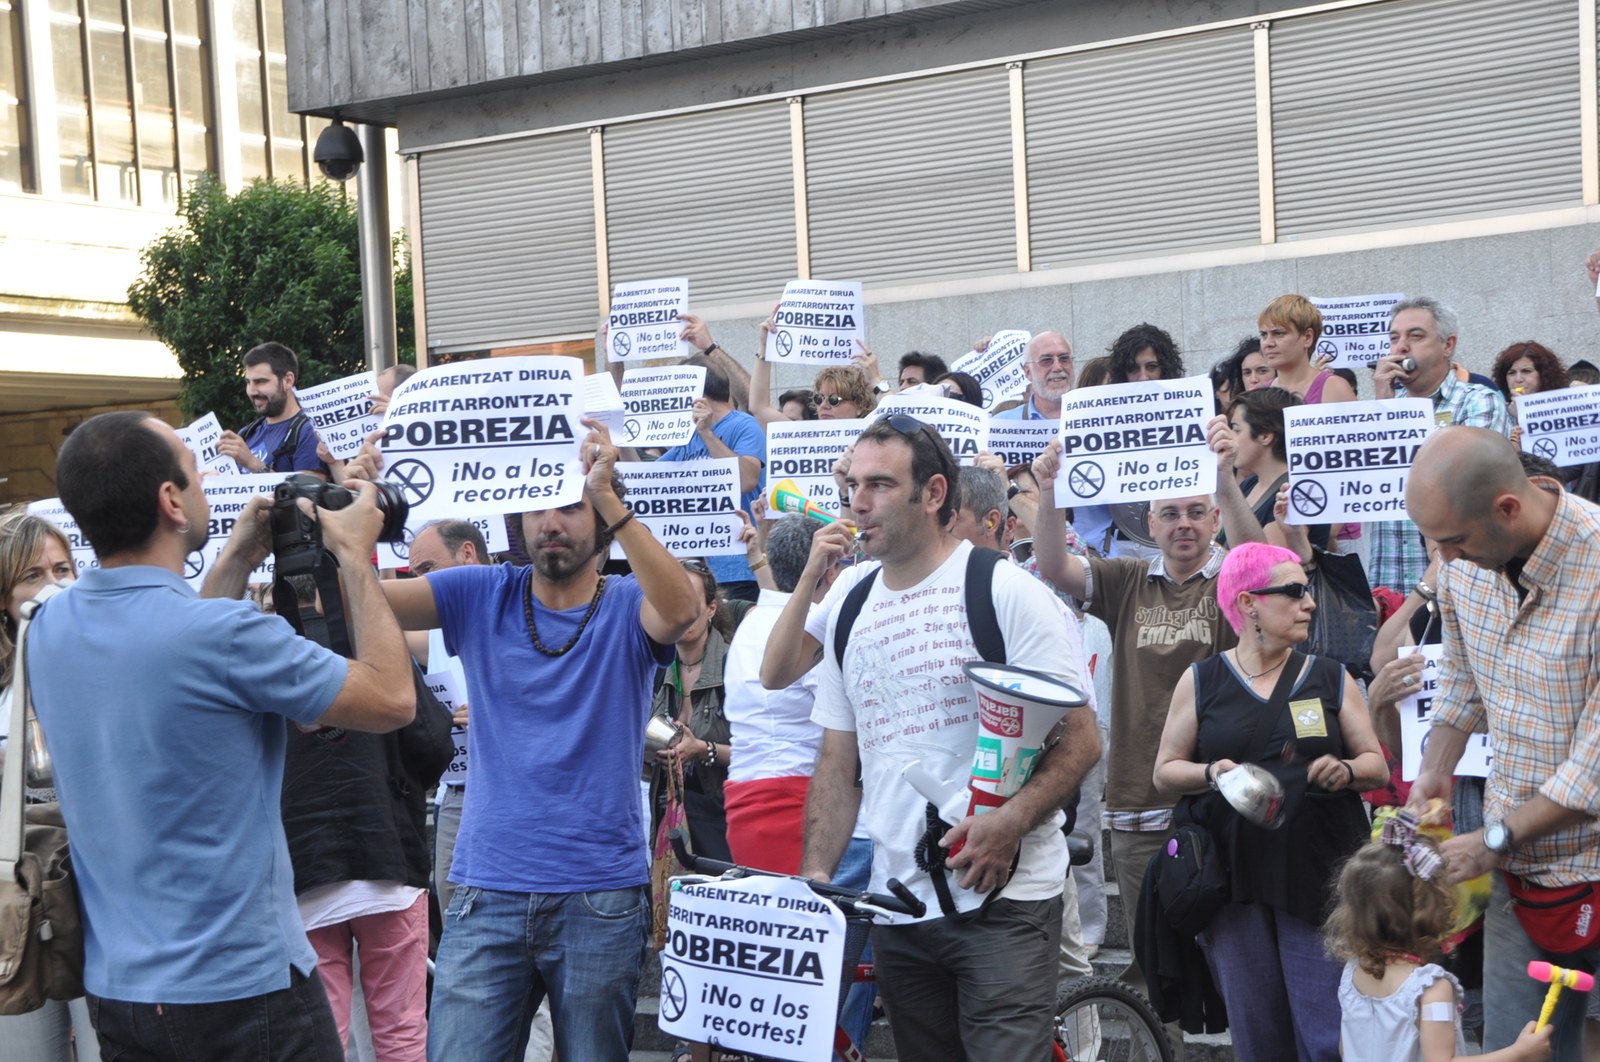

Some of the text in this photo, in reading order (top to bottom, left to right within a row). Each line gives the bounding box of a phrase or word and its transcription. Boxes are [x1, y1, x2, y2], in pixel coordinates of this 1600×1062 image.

[610, 309, 680, 326] POBREZIA
[776, 312, 856, 327] POBREZIA
[664, 330, 676, 340] los
[1324, 321, 1391, 335] OBREZI
[638, 341, 676, 353] recortes!
[834, 336, 852, 346] los
[1380, 340, 1390, 350] lo
[800, 348, 852, 358] recortes!
[519, 370, 572, 380] DIRUA
[344, 380, 370, 390] DIRUA
[620, 386, 696, 398] HERRITARRONTZAT
[389, 394, 572, 419] HERRITARRONTZAT
[1066, 390, 1202, 411] BANKARENTZAT DIRUA
[1524, 392, 1588, 408] BANKARENTZAT
[310, 400, 374, 428] BREZIA
[948, 408, 980, 422] DIRUA
[1526, 403, 1600, 420] HERRITARRONT
[677, 418, 690, 428] los
[1065, 408, 1204, 430] HERRITARRONTZAT
[1290, 410, 1426, 428] BANKARENTZAT DIRUA
[1527, 413, 1600, 434] POBREZ
[362, 422, 378, 434] los
[381, 414, 574, 448] POBREZIA
[646, 430, 690, 440] recortes!
[771, 430, 842, 440] BANKARENTZAT
[333, 438, 364, 452] recort
[1065, 424, 1206, 454] POBREZIA
[1290, 429, 1427, 447] HERRITARRONTZAT
[505, 464, 520, 478] a
[530, 458, 565, 478] los
[1156, 462, 1168, 473] a
[1175, 456, 1200, 471] los
[620, 468, 732, 480] ANKARENTZAT DIRUA
[626, 483, 733, 496] ERRITARRONTZAT
[1120, 472, 1199, 493] recortes!
[1380, 483, 1391, 493] a
[204, 486, 255, 496] RENTZAT
[453, 480, 564, 502] recortes!
[1344, 497, 1406, 513] recorte
[695, 526, 704, 534] a
[710, 522, 731, 534] los
[666, 536, 731, 549] recortes!
[942, 586, 960, 594] and
[854, 626, 872, 638] were
[924, 604, 938, 615] the
[932, 639, 963, 650] being
[944, 714, 969, 726] man
[777, 897, 832, 915] DIRUA
[670, 904, 830, 944] ERRITARRONTZAT
[750, 997, 764, 1013] a
[773, 994, 810, 1020] los
[702, 1014, 807, 1046] recortes!
